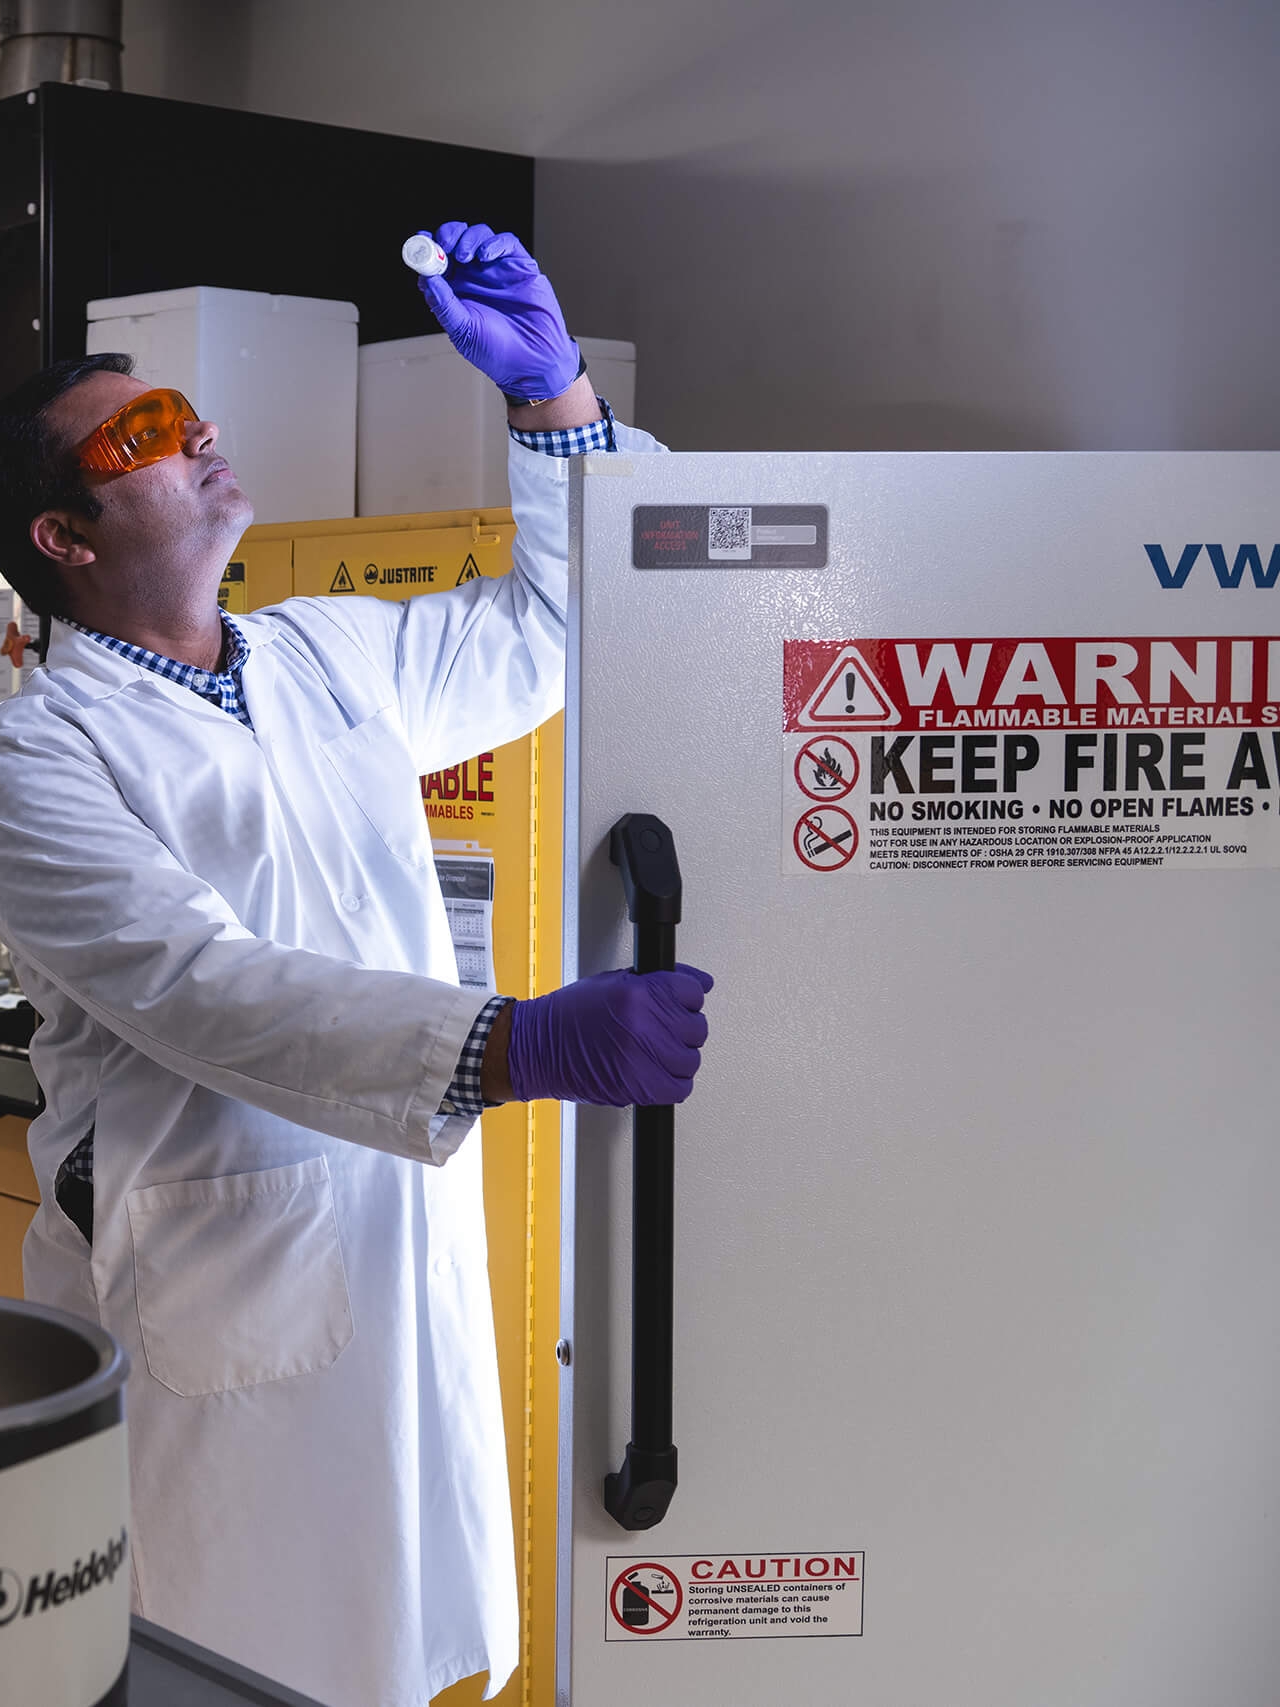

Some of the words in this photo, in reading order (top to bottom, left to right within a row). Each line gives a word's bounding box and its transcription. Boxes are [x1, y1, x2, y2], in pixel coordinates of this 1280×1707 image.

[920, 709, 1096, 728] FLAMMABLE
[1107, 707, 1251, 726] MATERIAL
[1261, 706, 1280, 724] S
[871, 734, 1040, 794] KEEP
[1064, 732, 1206, 792] FIRE
[1226, 731, 1280, 790] A
[419, 752, 494, 801] ABLE
[870, 801, 904, 821] NO
[912, 800, 1024, 821] SMOKING
[1049, 799, 1083, 819] NO
[1091, 798, 1154, 818] OPEN
[1162, 797, 1254, 817] FLAMES
[870, 828, 889, 836] THIS
[892, 828, 942, 836] EQUIPMENT
[944, 827, 951, 835] IS
[954, 827, 996, 835] INTENDED
[999, 826, 1016, 834] FOR
[1018, 826, 1056, 834] STORING
[1058, 825, 1110, 833] FLAMMABLE
[1113, 824, 1160, 832] MATERIALS
[870, 839, 888, 847] NOT
[890, 839, 908, 847] FOR
[910, 839, 927, 847] USE
[960, 838, 1012, 846] HAZARDOUS
[1015, 837, 1057, 845] LOCATION
[1074, 835, 1154, 844] EXPLOSION-PROOF
[1156, 835, 1211, 843] APPLICATION
[870, 850, 899, 858] MEETS
[901, 849, 968, 858] REQUIREMENTS
[970, 849, 982, 857] OF
[989, 849, 1013, 857] OSHA
[1027, 848, 1044, 856] CFR
[1099, 847, 1120, 855] NFPA
[1122, 847, 1132, 856] 45
[870, 861, 910, 869] CAUTION:
[913, 860, 968, 869] DISCONNECT
[970, 860, 994, 868] FROM
[1031, 859, 1065, 867] BEFORE
[1067, 858, 1112, 866] SERVICING
[1114, 857, 1164, 866] EQUIPMENT
[691, 1557, 856, 1579] CAUTION
[688, 1585, 724, 1595] Storing
[726, 1584, 780, 1593] UNSEALED
[783, 1584, 833, 1592] containers
[836, 1583, 846, 1591] of
[688, 1597, 733, 1605] corrosive
[736, 1595, 779, 1603] materials
[688, 1607, 740, 1616] permanent
[742, 1606, 779, 1615] damage
[782, 1605, 791, 1613] to
[794, 1604, 811, 1613] this
[688, 1617, 746, 1627] refrigeration
[749, 1616, 767, 1625] unit
[770, 1616, 788, 1624] and
[790, 1615, 810, 1624] void
[813, 1615, 828, 1623] the
[688, 1628, 731, 1637] warranty.
